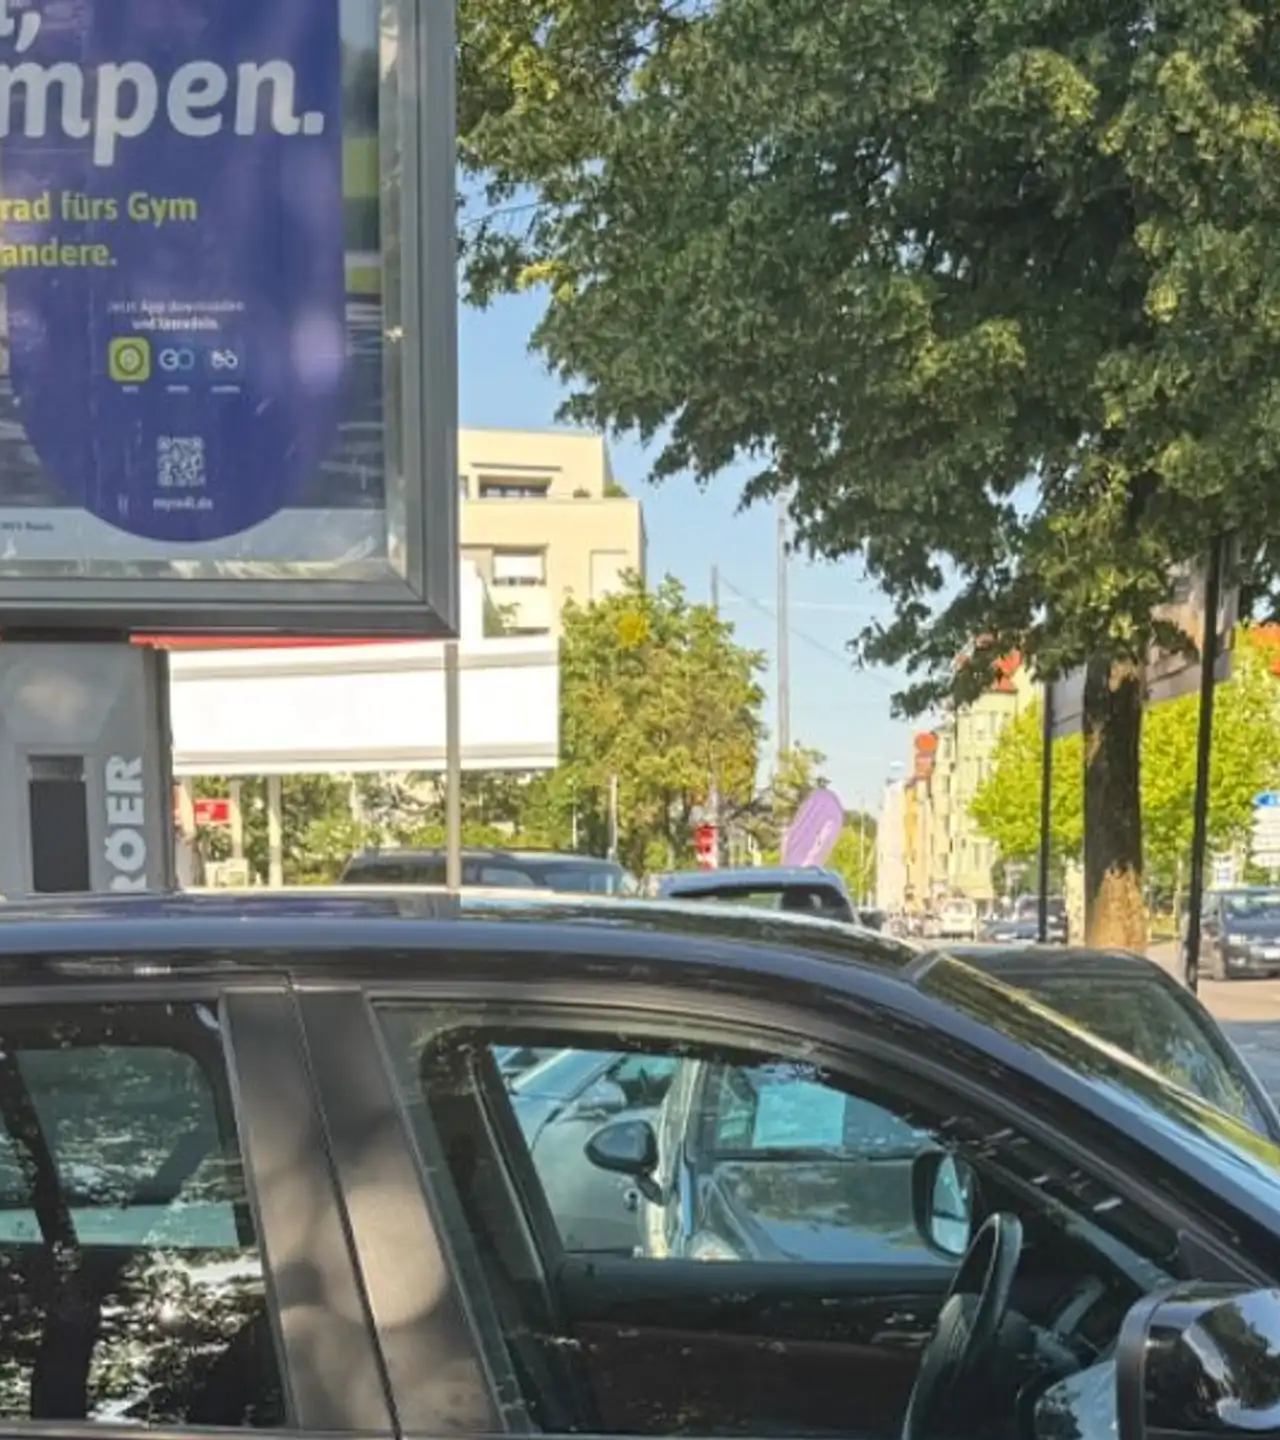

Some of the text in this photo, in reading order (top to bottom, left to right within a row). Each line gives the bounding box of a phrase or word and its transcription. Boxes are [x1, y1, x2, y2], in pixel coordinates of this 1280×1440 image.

[61, 190, 118, 221] fürs
[127, 191, 197, 228] Gym
[3, 236, 117, 267] andere.
